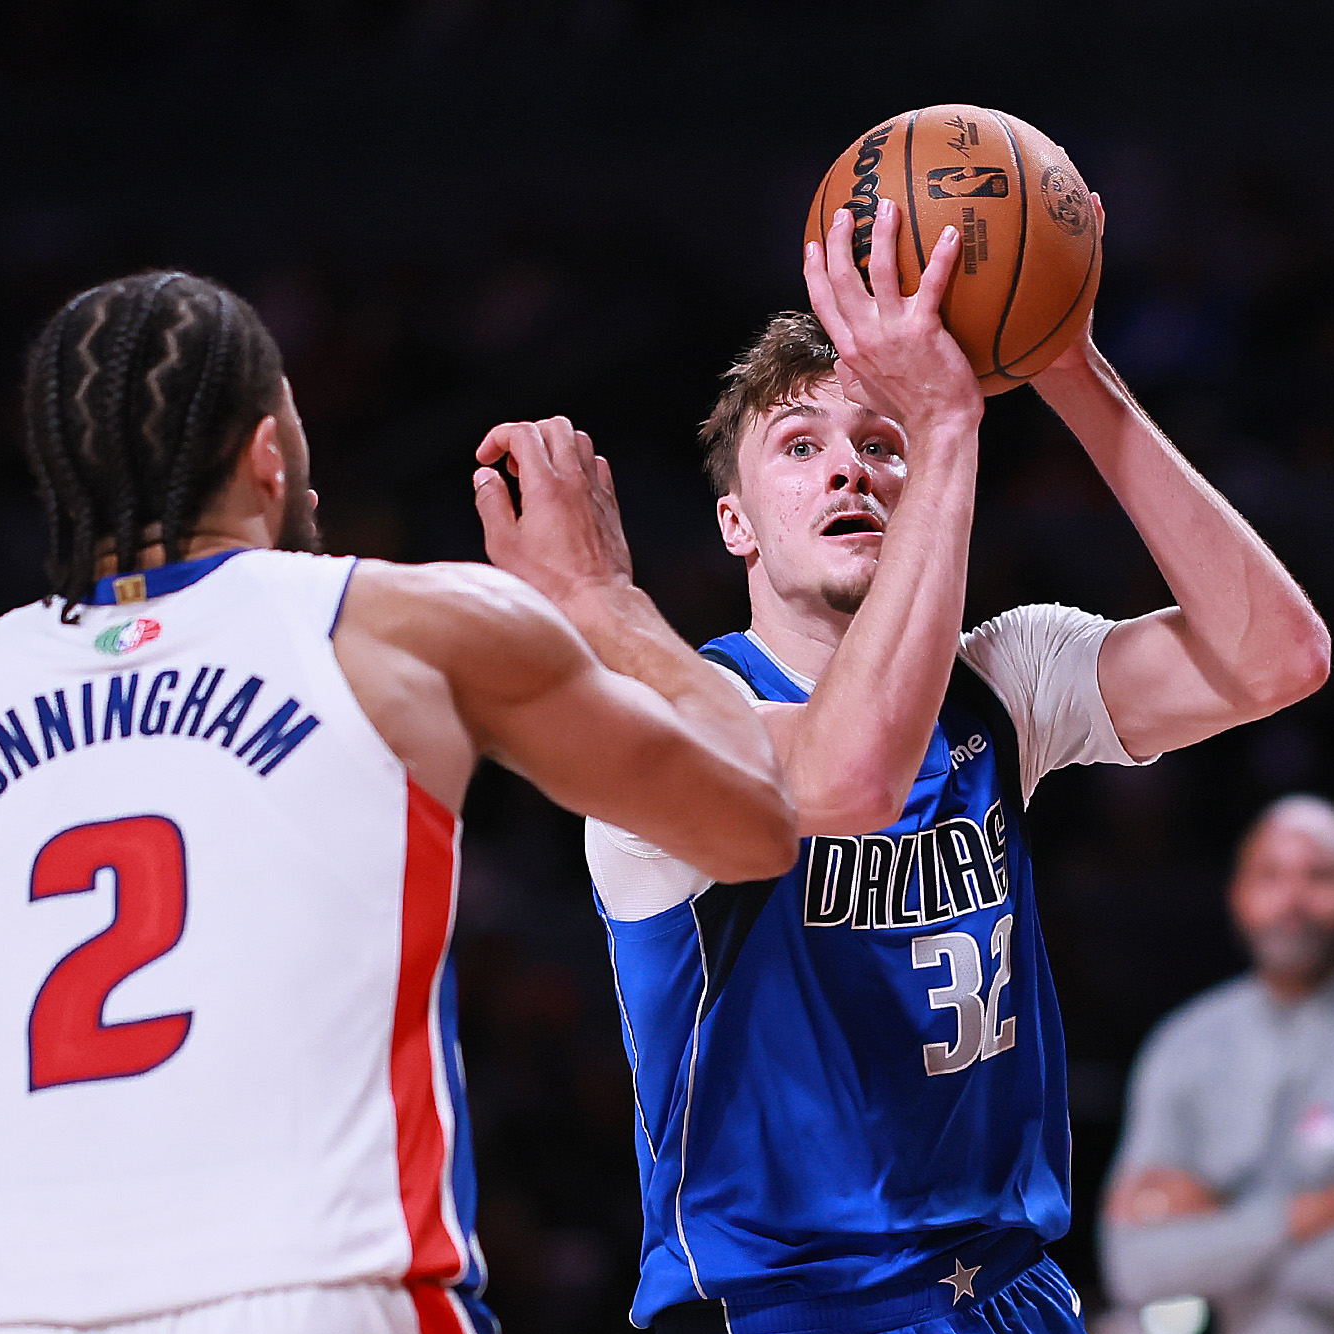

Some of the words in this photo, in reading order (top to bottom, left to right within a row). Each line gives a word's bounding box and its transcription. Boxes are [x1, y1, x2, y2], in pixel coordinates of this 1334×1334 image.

[804, 798, 1010, 930] DALLAS
[28, 813, 193, 1094] 2
[911, 913, 1016, 1077] 32
